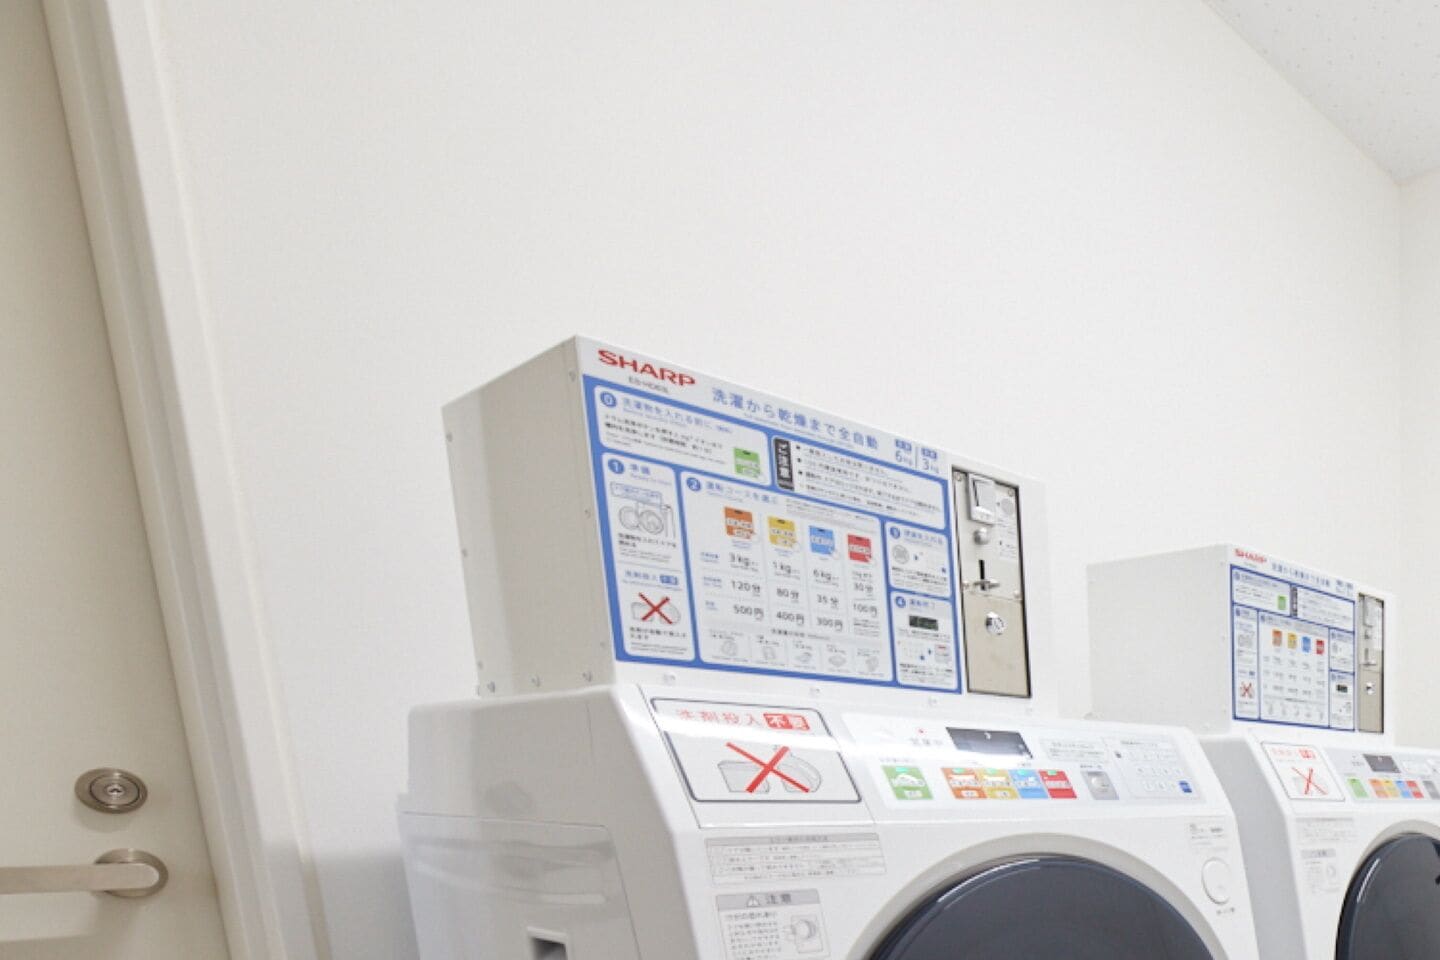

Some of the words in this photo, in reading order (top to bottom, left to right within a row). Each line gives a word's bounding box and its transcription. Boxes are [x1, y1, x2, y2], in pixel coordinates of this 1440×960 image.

[598, 349, 696, 386] SHARP
[712, 387, 878, 450] 洗濯から乾燥まで全自動
